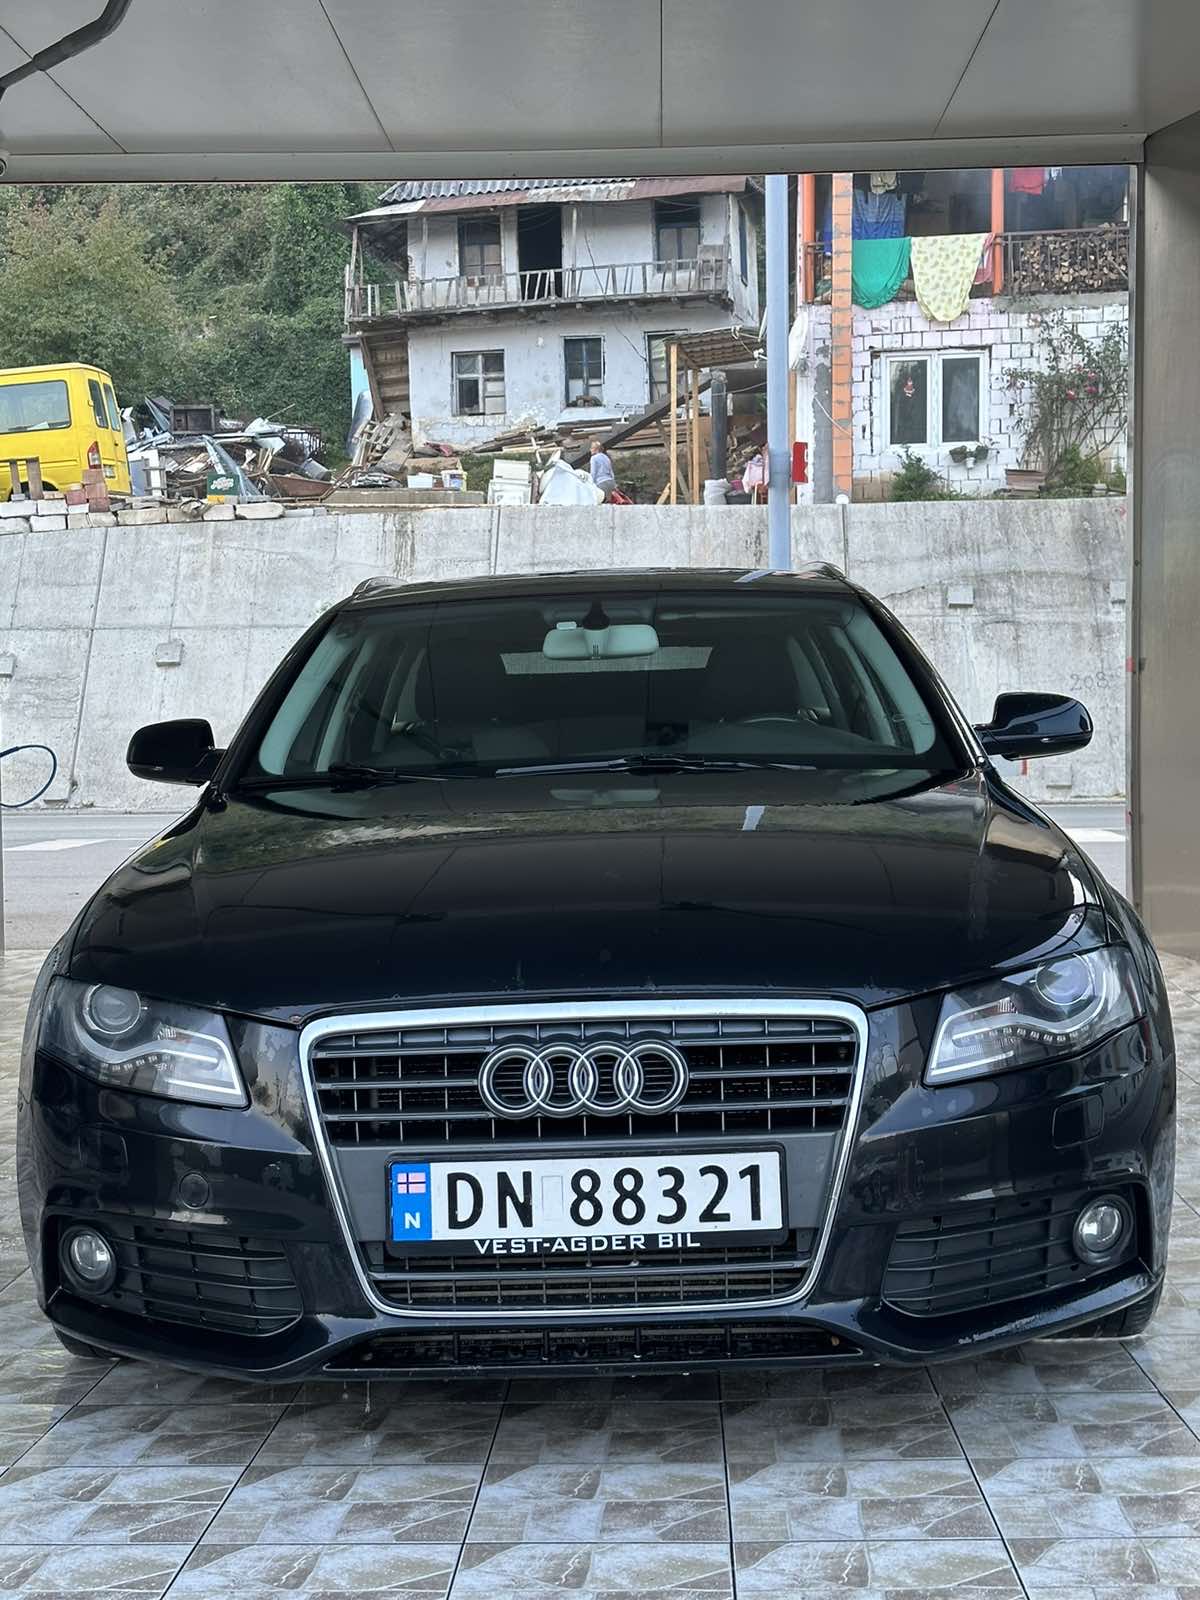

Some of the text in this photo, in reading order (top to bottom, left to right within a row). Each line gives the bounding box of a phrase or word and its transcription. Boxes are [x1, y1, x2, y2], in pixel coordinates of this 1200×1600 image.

[447, 1165, 762, 1230] DN 88321
[404, 1212, 421, 1229] N
[473, 1233, 701, 1255] VEST-AGDER BIL
